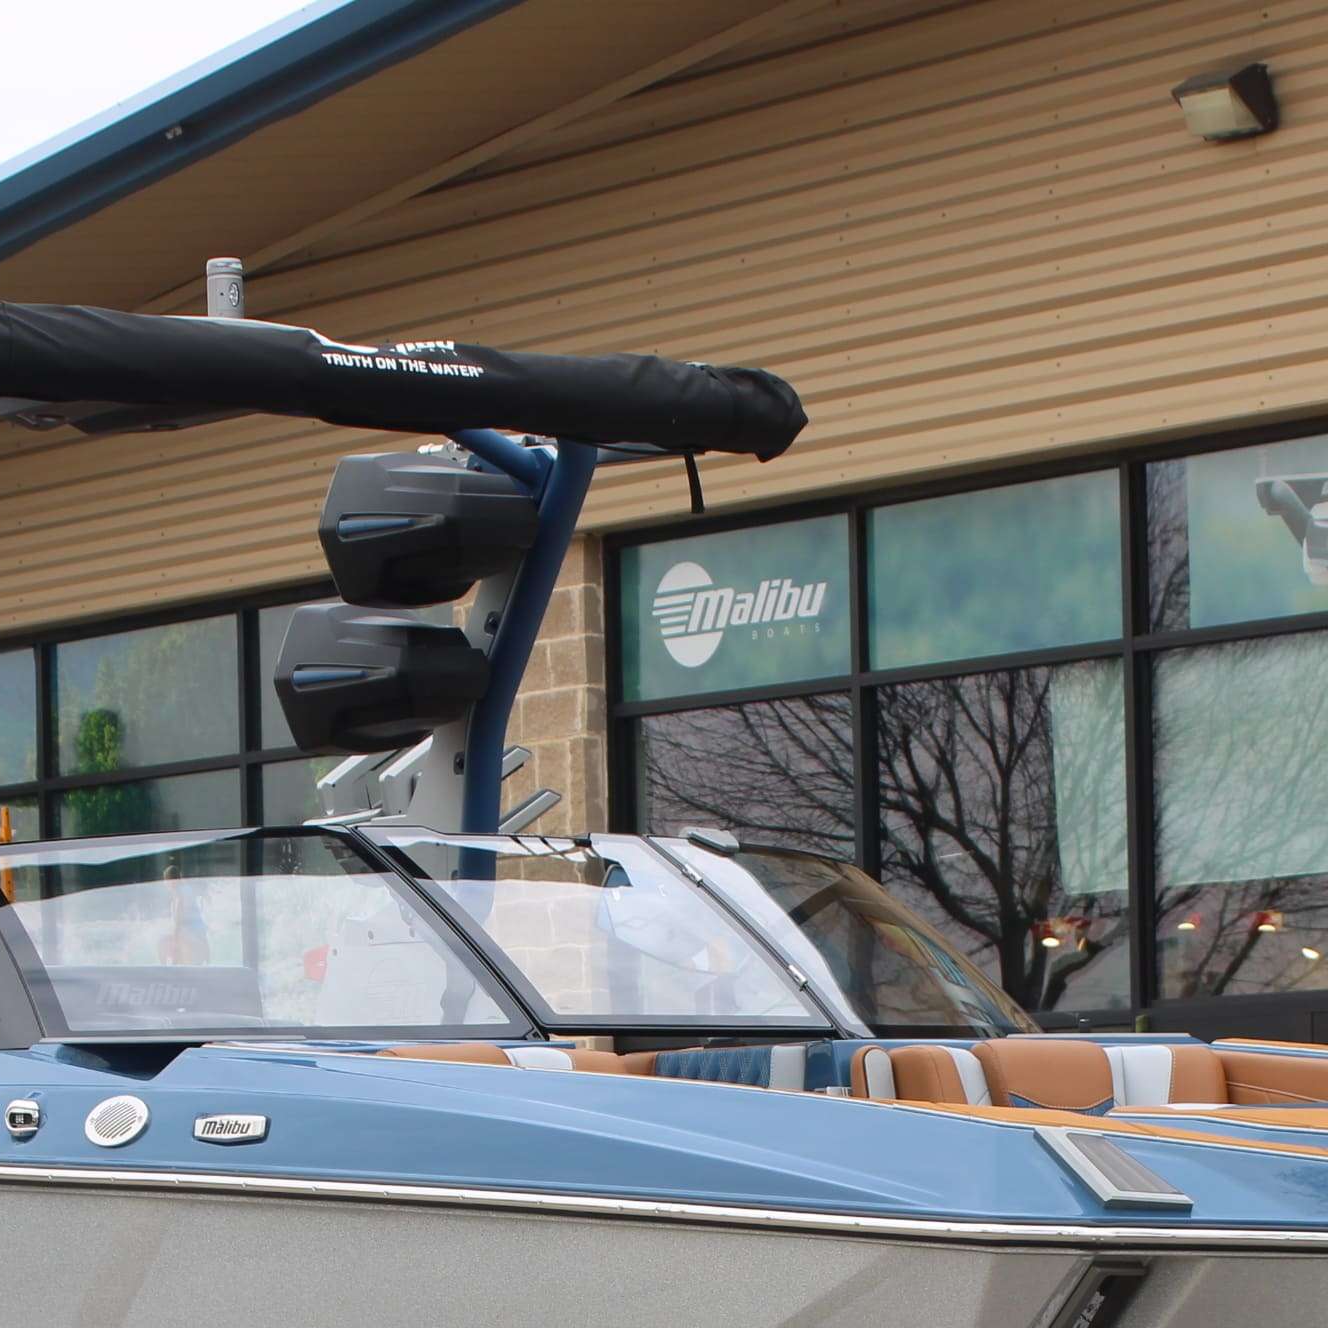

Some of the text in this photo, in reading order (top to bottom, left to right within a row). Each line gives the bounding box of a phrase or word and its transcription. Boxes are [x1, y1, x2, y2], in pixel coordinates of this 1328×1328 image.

[322, 352, 373, 369] TRUTH
[377, 357, 397, 371] ON
[399, 359, 428, 374] THE
[687, 578, 827, 633] Malibu
[751, 622, 821, 641] BOATS
[201, 1119, 251, 1135] Malibu
